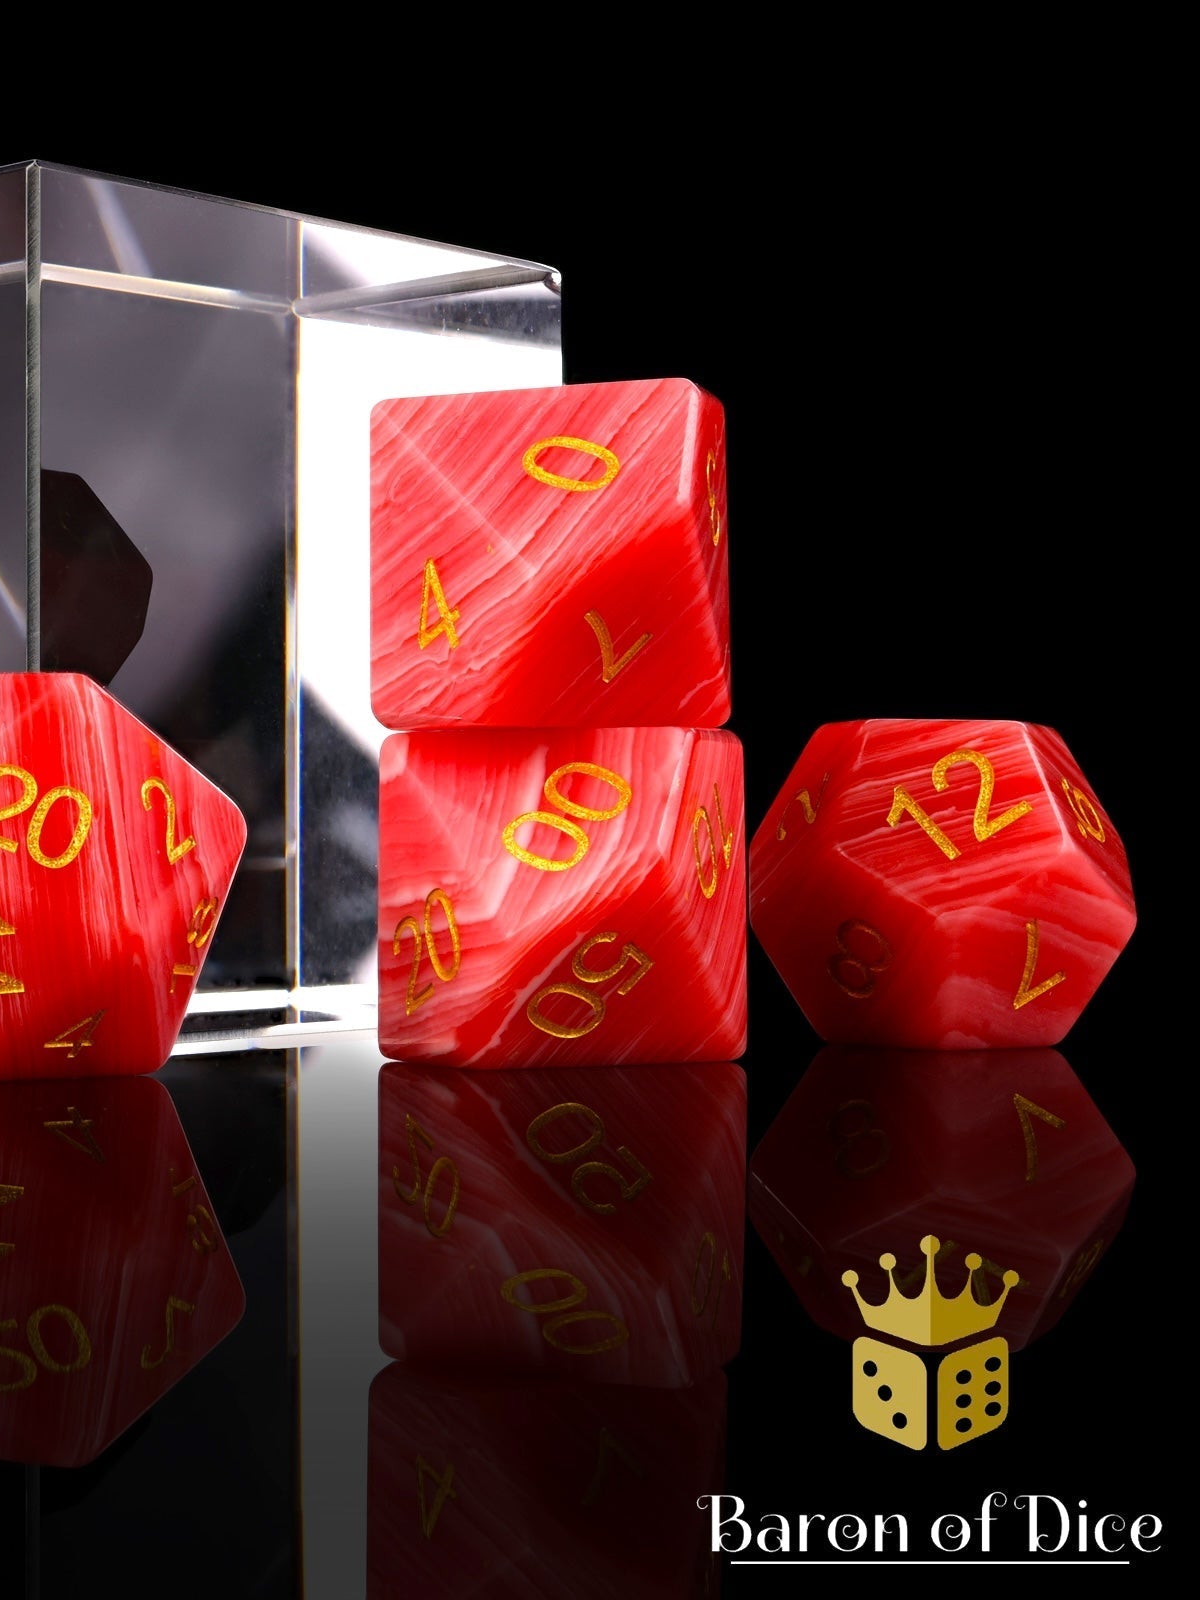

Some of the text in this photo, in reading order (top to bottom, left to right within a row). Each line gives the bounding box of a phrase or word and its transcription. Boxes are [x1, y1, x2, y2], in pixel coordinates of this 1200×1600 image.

[522, 436, 620, 492] 0
[418, 557, 461, 649] 4
[141, 776, 196, 865] 2
[502, 762, 632, 872] 00
[886, 749, 1033, 860] 12
[393, 888, 461, 1016] 20
[527, 931, 655, 1039] 50
[826, 918, 892, 999] 8
[43, 1008, 106, 1058] 4
